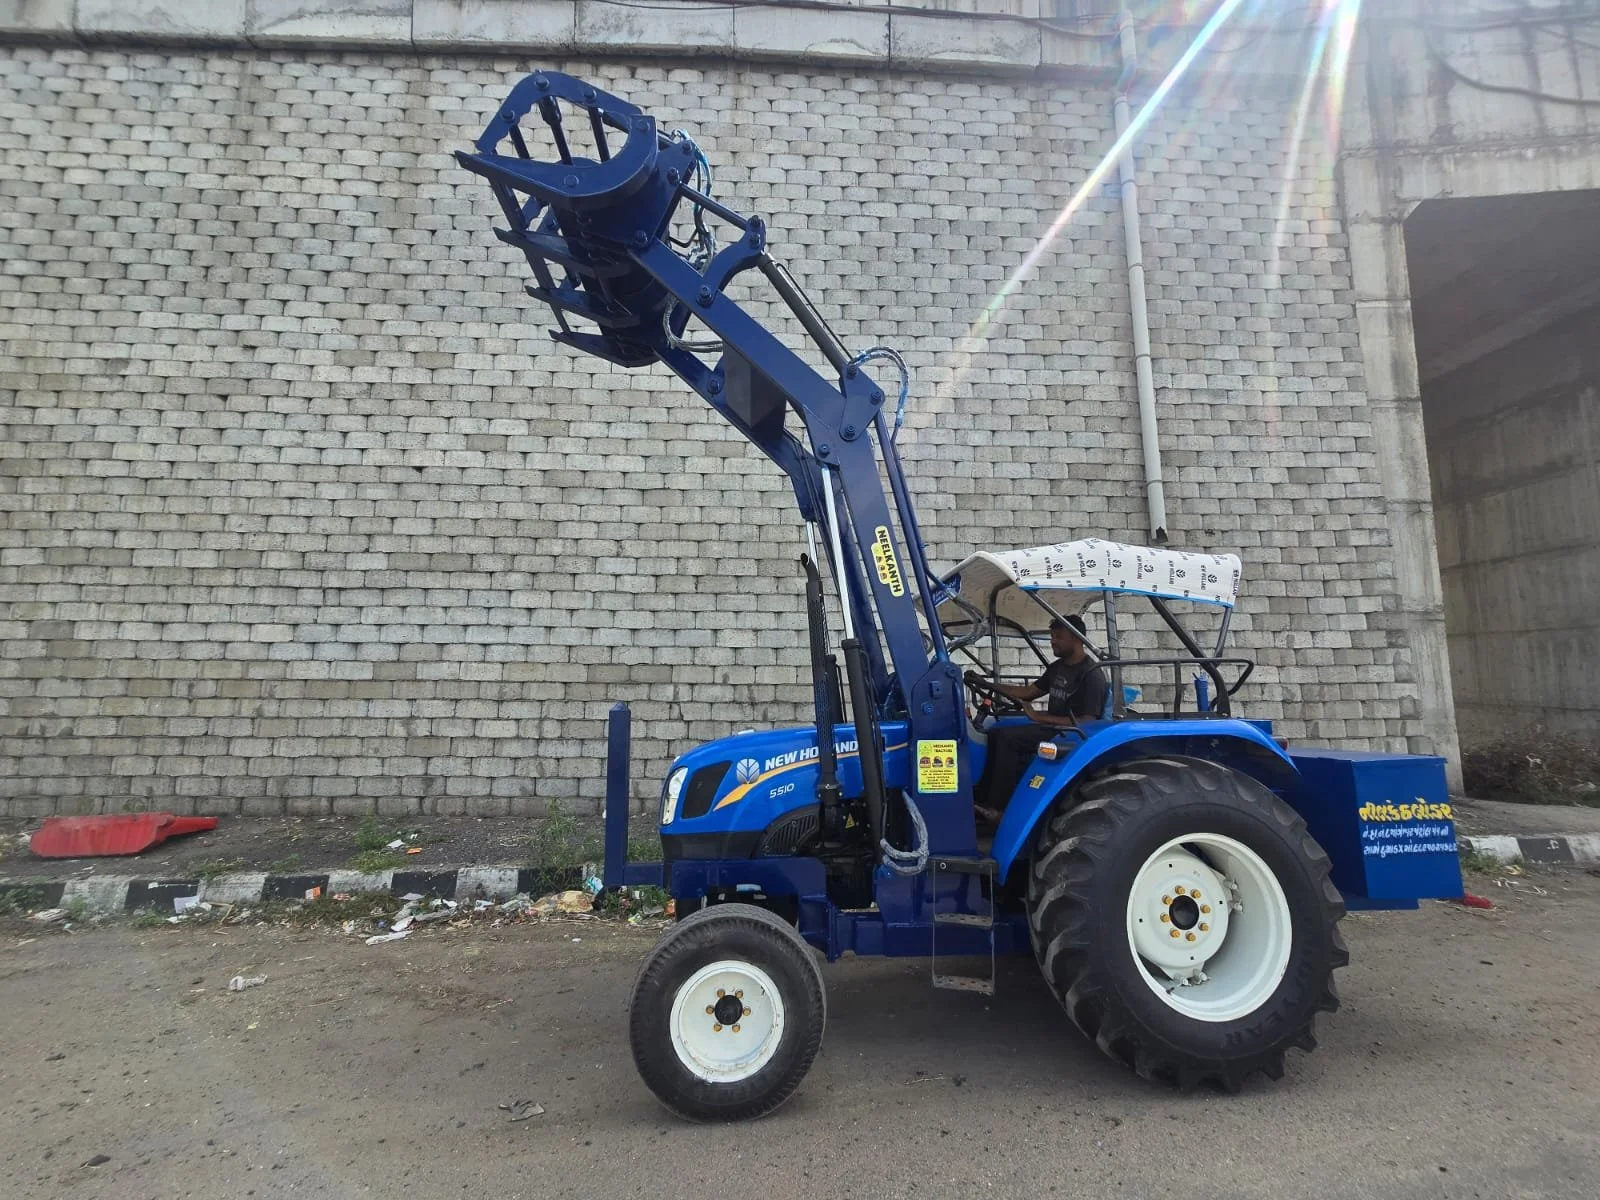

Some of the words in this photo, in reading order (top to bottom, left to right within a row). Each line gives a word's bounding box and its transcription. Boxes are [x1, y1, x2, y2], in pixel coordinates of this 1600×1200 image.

[877, 529, 902, 593] NEELKANTH
[765, 750, 798, 771] NEW
[800, 740, 859, 761] HOAND
[769, 783, 795, 799] 5510
